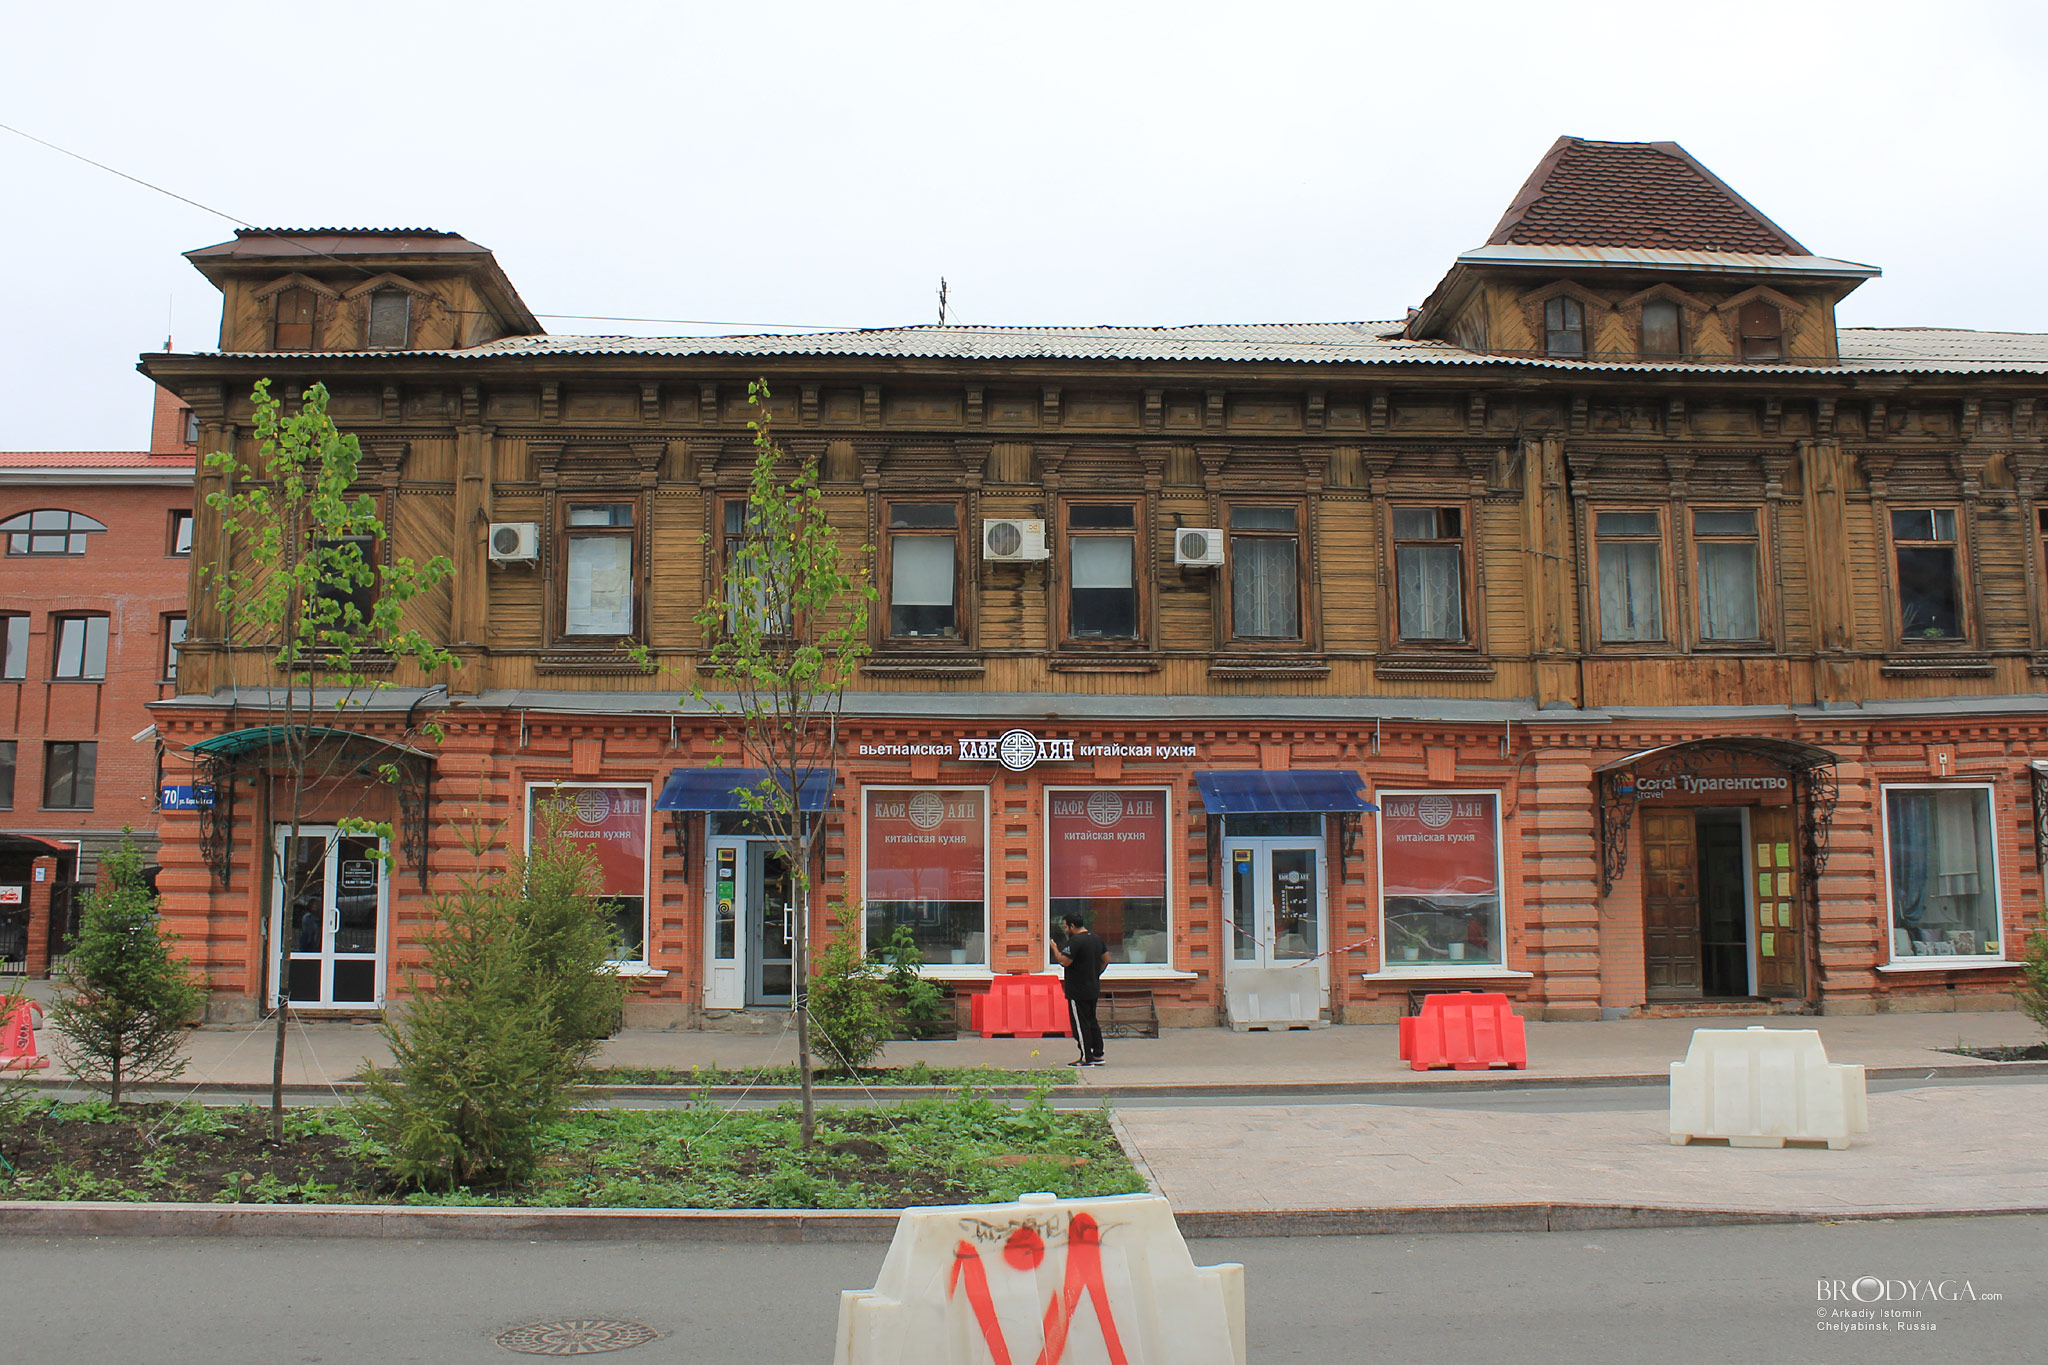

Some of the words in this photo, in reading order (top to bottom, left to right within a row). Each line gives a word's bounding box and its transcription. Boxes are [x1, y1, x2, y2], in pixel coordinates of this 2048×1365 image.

[859, 744, 953, 755] вьетнамская
[959, 741, 998, 759] КАФЕ
[1036, 741, 1074, 759] АЯН
[1080, 743, 1152, 756] китайская
[1156, 745, 1197, 760] кухня
[1636, 776, 1677, 790] Coral
[1680, 774, 1788, 794] Турагентство
[164, 789, 177, 805] 70
[1636, 790, 1664, 799] travel
[613, 799, 640, 814] АЯН
[875, 803, 906, 818] КАФЕ
[948, 803, 975, 818] АЯН
[1054, 800, 1085, 815] КАФЕ
[1126, 800, 1153, 815] АЯН
[1385, 803, 1416, 817] КАФЕ
[1456, 803, 1483, 817] АЯН
[603, 830, 632, 841] кухня
[885, 832, 936, 843] китайская
[938, 834, 967, 846] кухня
[1064, 830, 1114, 840] китайская
[1117, 832, 1146, 843] кухня
[1396, 832, 1445, 843] китайская
[1447, 833, 1476, 845] кухня
